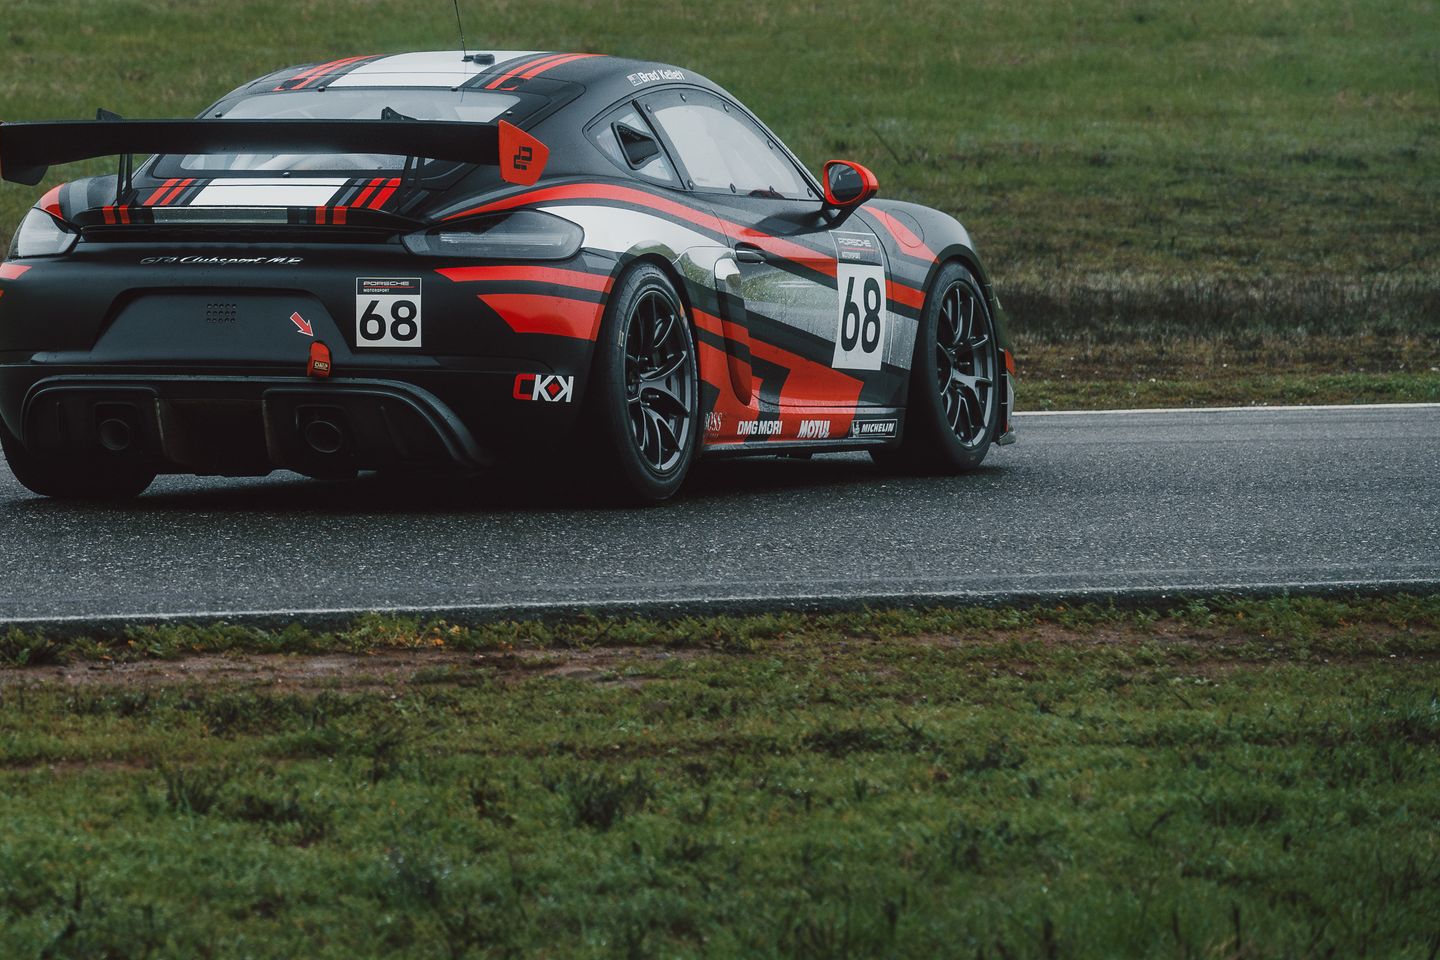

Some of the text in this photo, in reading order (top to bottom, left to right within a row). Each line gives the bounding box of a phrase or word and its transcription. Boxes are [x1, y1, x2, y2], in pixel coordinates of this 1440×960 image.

[637, 70, 660, 83] Brad
[838, 237, 872, 249] PORSCHE
[180, 255, 266, 266] Clubsport
[360, 300, 418, 342] 68
[841, 276, 882, 354] 68
[737, 420, 783, 435] DMG MORI
[797, 419, 831, 439] MOTUL
[861, 422, 895, 433] MICHELIN
